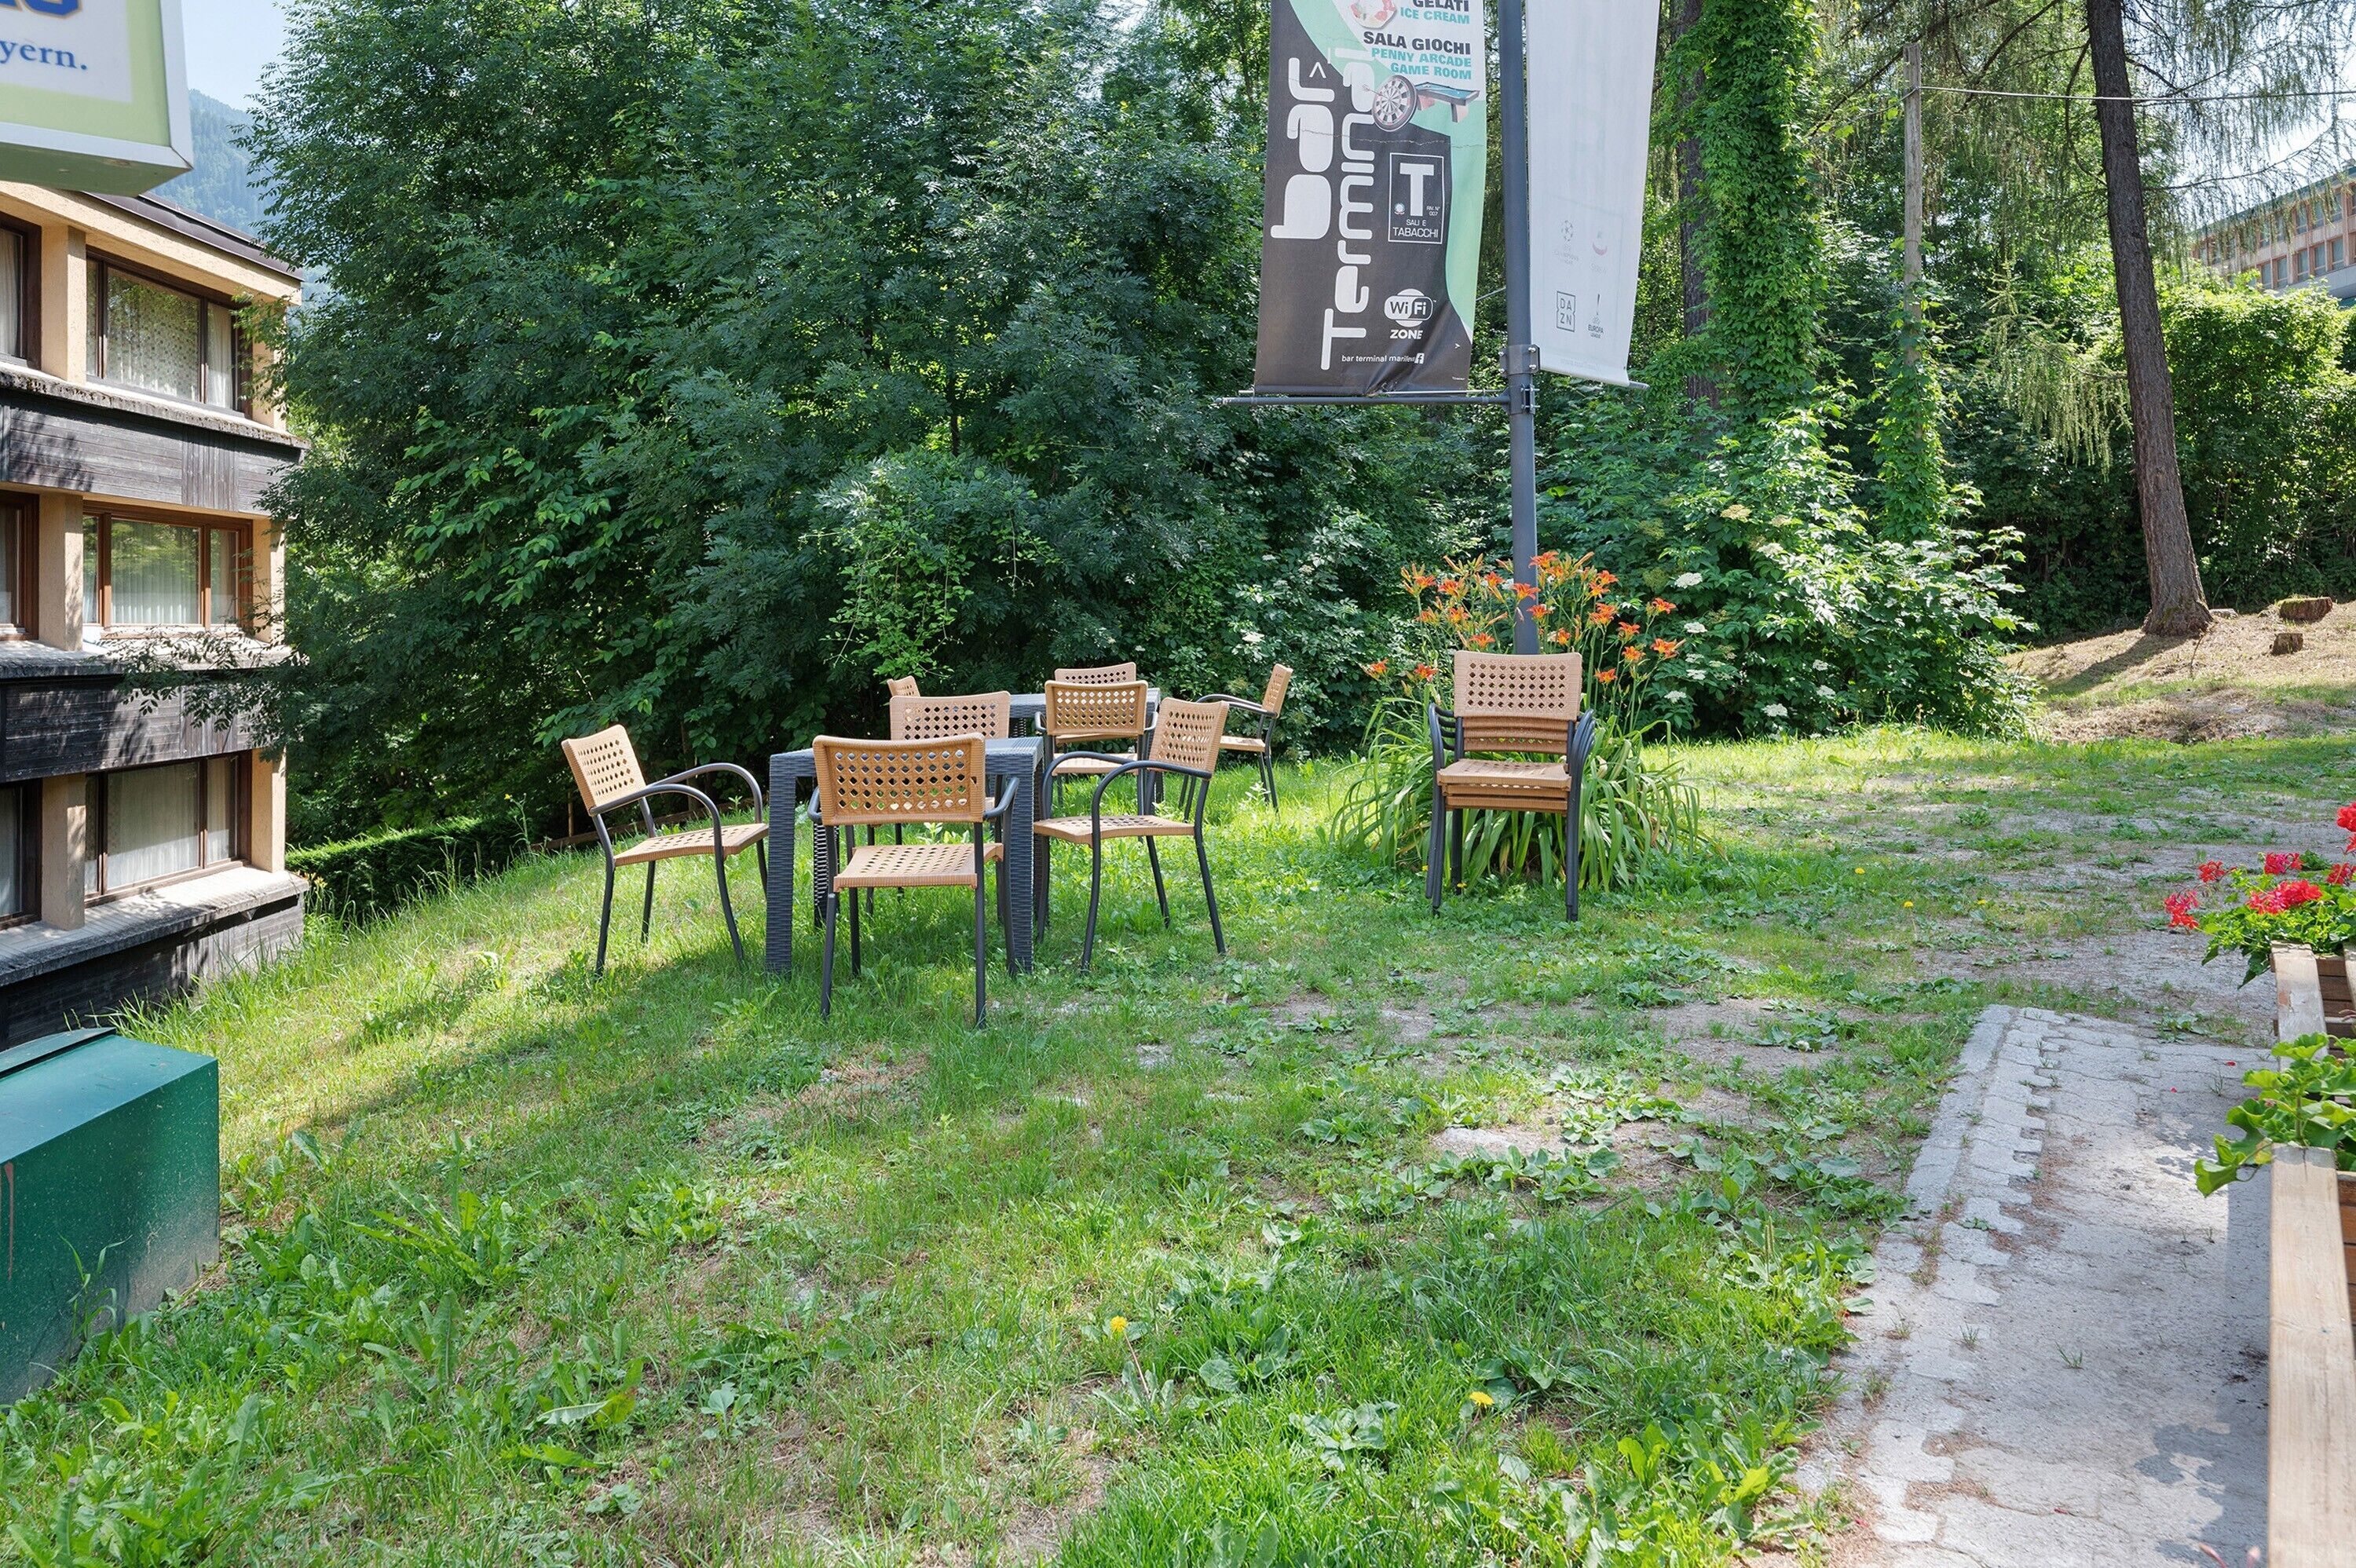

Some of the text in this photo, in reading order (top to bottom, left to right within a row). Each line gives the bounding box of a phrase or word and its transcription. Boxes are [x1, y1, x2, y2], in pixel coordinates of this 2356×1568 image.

[1413, 0, 1469, 12] GELATI
[1400, 7, 1470, 24] ICE CREAM
[1363, 31, 1471, 55] SALA GIOCHI
[1372, 47, 1472, 68] PENNY ARCADE
[1391, 63, 1472, 79] GAME ROOM
[1399, 163, 1435, 217] T
[1320, 48, 1374, 370] Terminal
[1392, 227, 1439, 238] TABACCHI
[1390, 330, 1423, 339] ZONE
